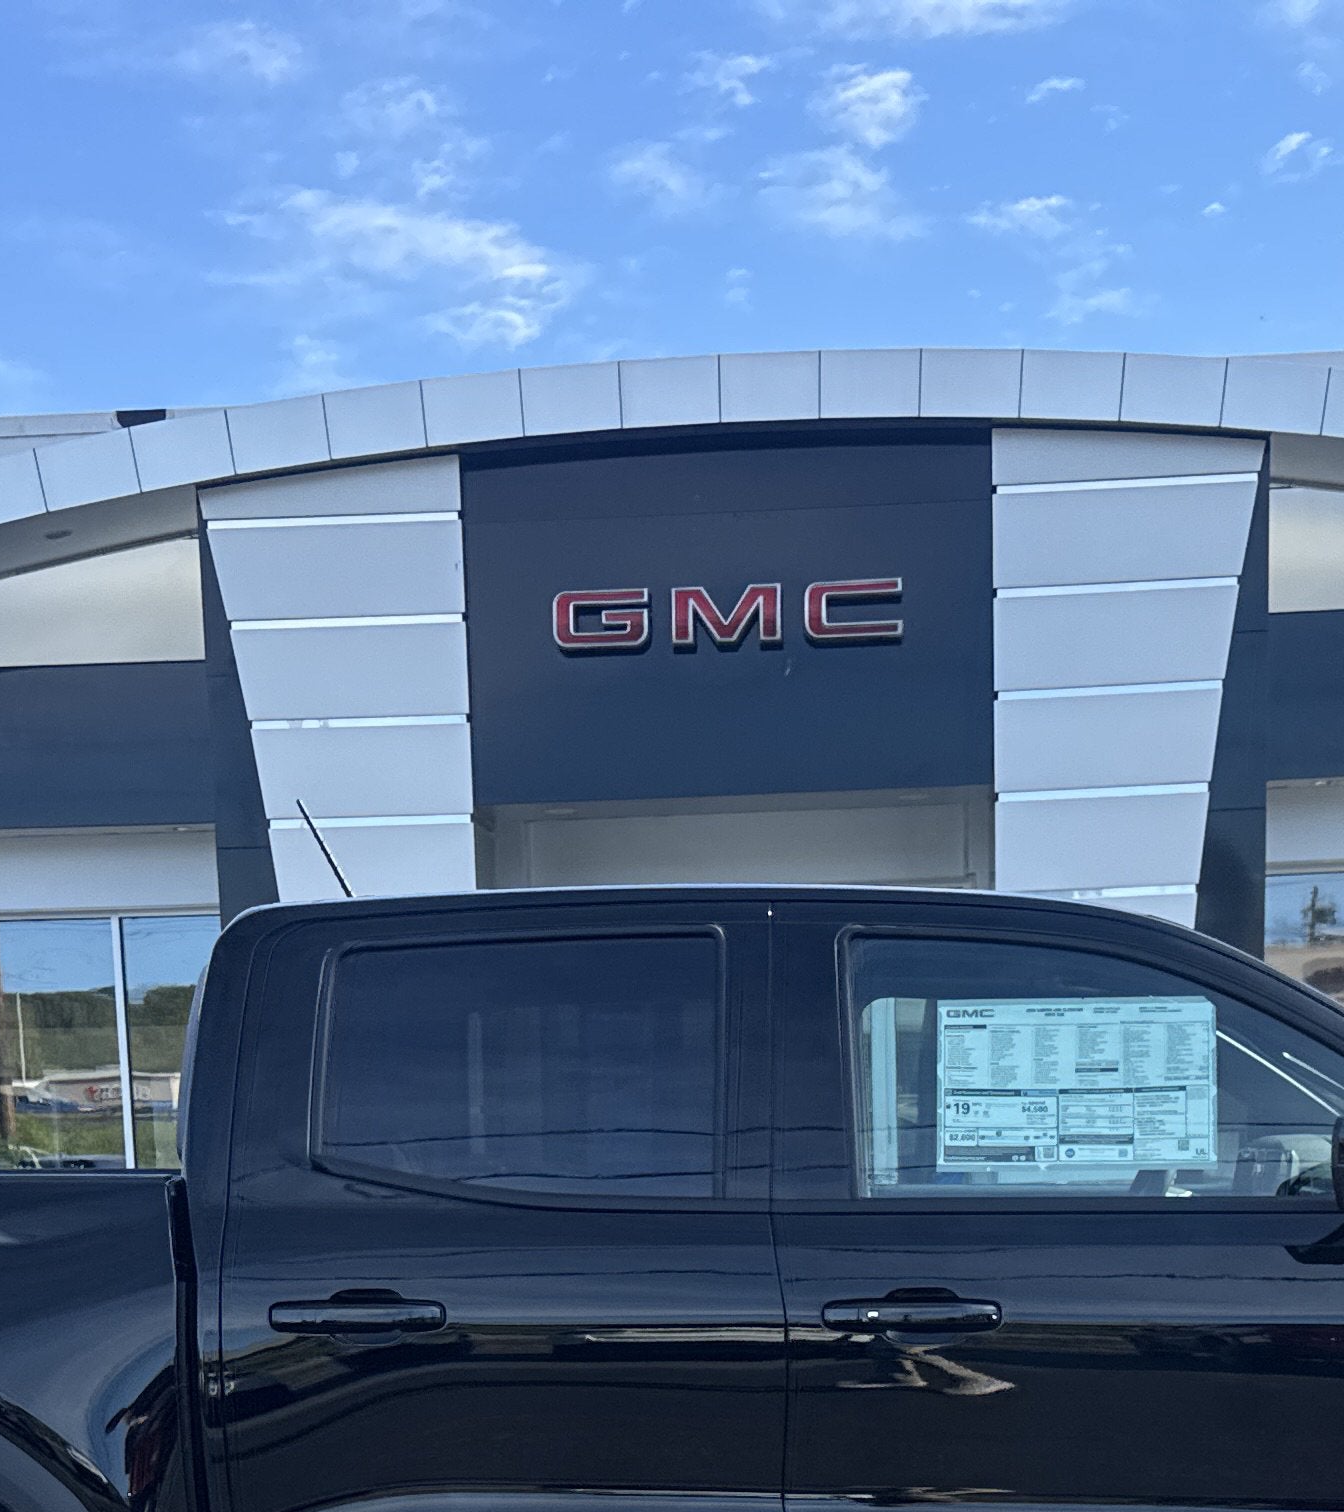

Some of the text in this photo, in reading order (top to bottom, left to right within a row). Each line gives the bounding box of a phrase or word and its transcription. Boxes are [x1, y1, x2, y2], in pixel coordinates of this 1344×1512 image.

[552, 577, 904, 650] GMC
[946, 1008, 995, 1018] GMC
[953, 1102, 970, 1115] 19
